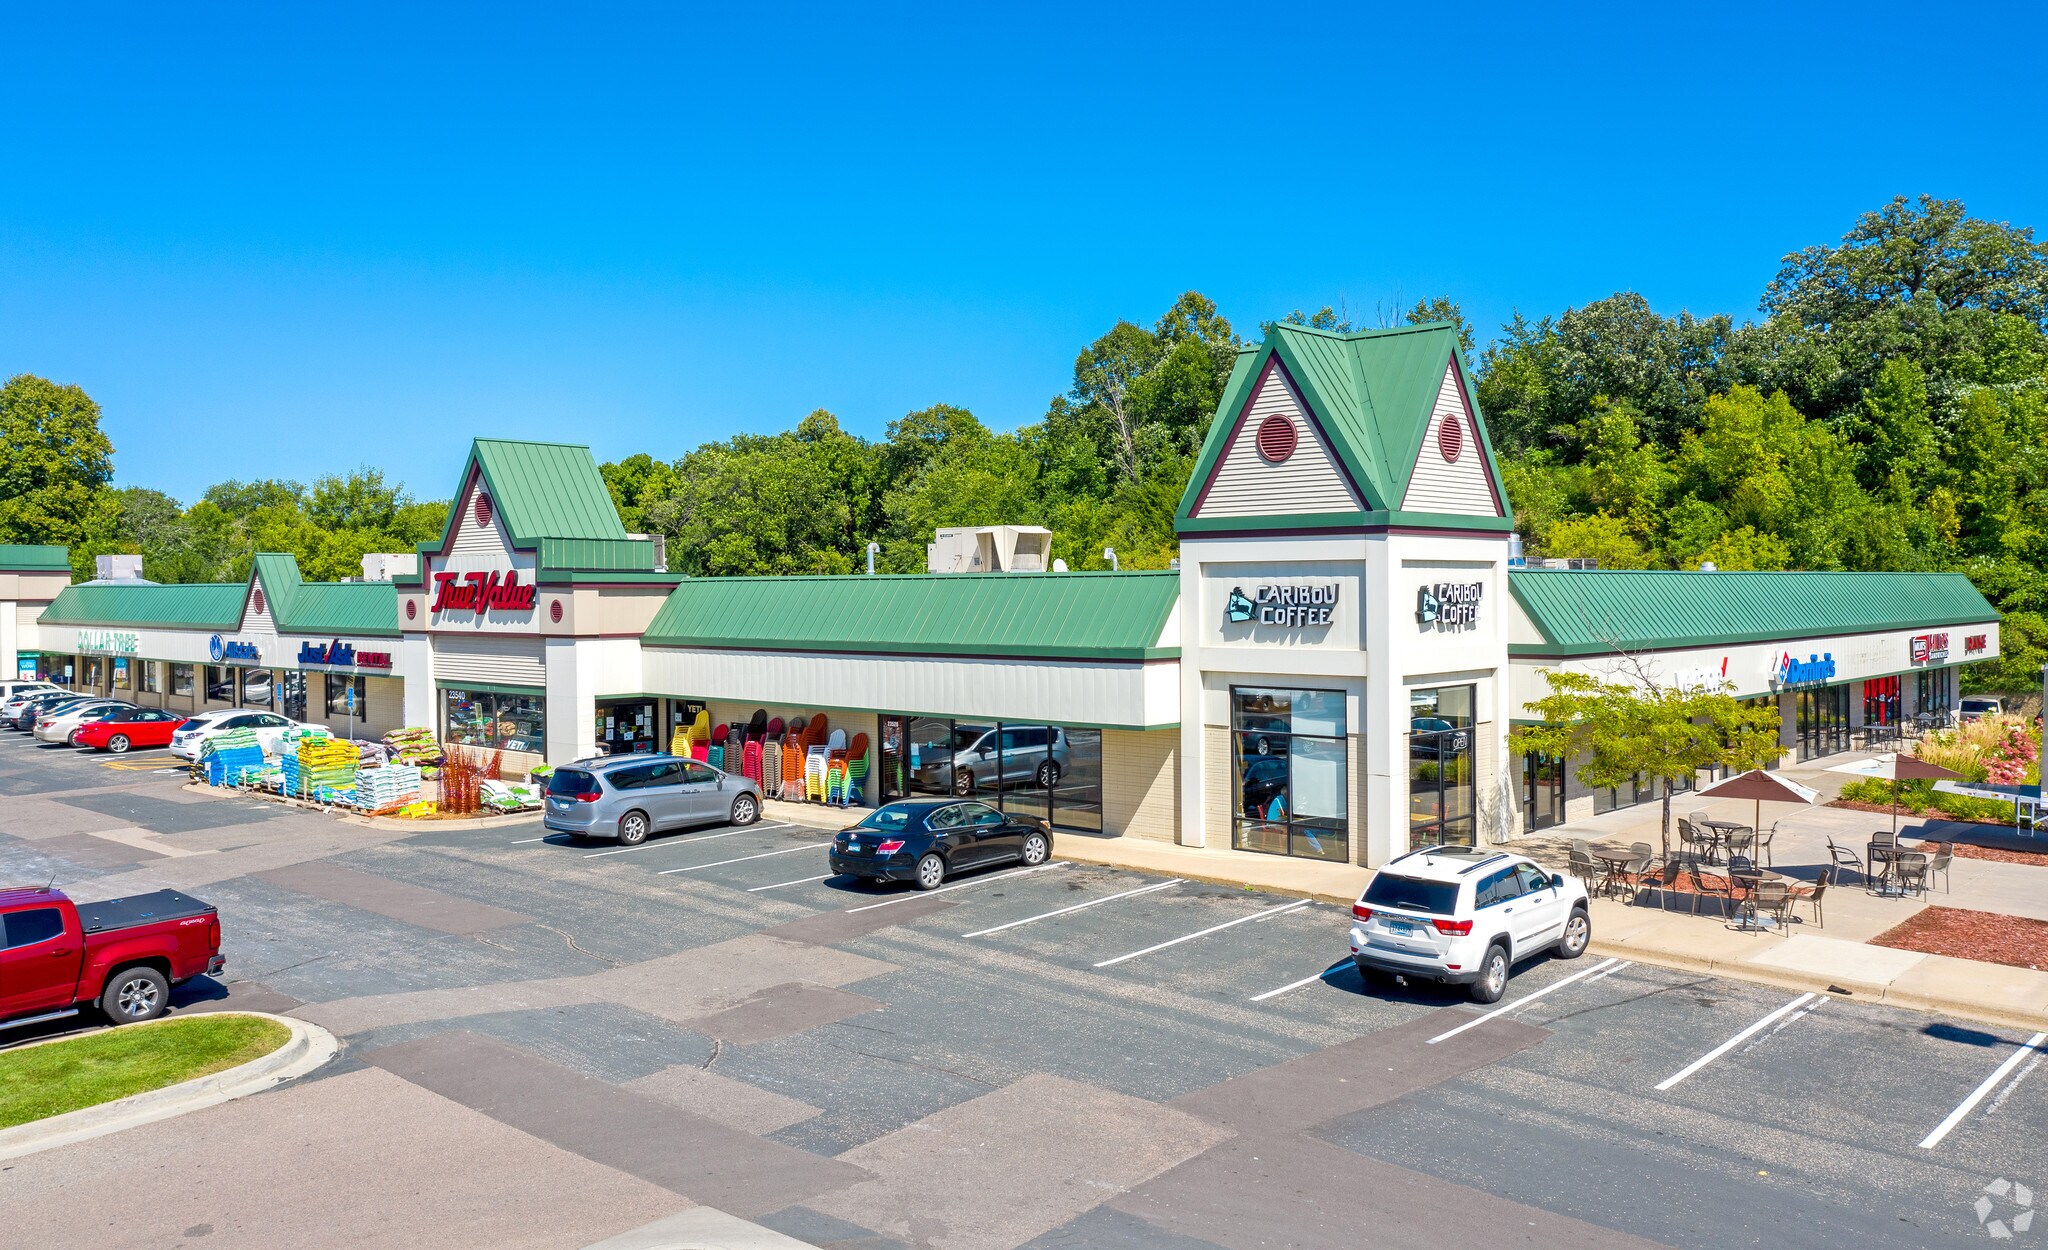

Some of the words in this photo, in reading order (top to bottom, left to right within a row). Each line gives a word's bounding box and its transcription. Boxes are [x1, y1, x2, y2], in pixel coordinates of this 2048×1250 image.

[1255, 584, 1339, 606] CARIBOU
[1437, 582, 1484, 603] CARIBOU
[1260, 606, 1334, 627] COFFEE
[1441, 604, 1481, 625] COFFEE
[77, 631, 111, 650] DOLLAR
[113, 633, 137, 652] TREE
[357, 652, 391, 665] RENTAL
[1786, 653, 1836, 684] Domino's
[449, 691, 466, 700] 23540
[506, 739, 525, 751] YETI
